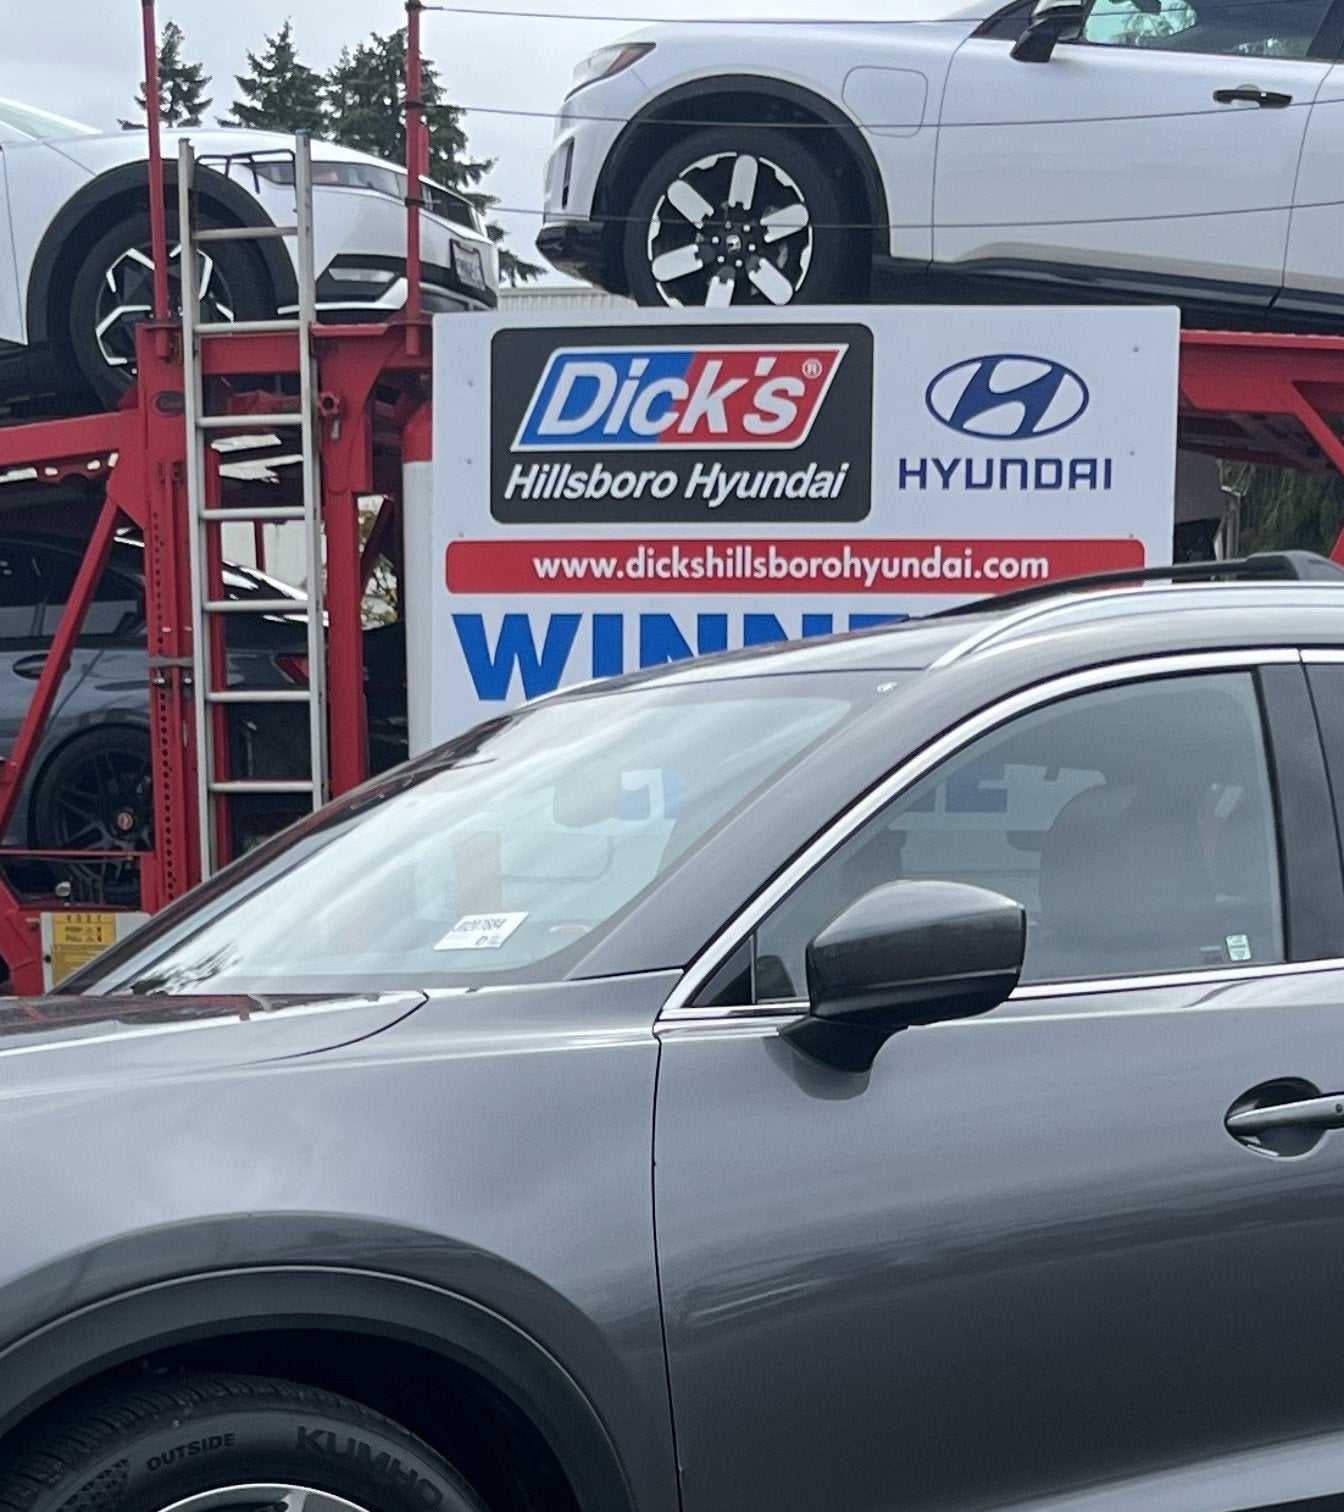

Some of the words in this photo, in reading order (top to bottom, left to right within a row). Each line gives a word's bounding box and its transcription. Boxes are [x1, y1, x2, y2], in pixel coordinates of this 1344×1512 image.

[504, 462, 679, 500] Hillsboro
[684, 462, 849, 508] Hyundai
[899, 457, 1112, 490] HYUNDAI
[532, 546, 1050, 588] www.dickshillsborohyundai.com
[146, 1432, 237, 1471] OUTSIDE
